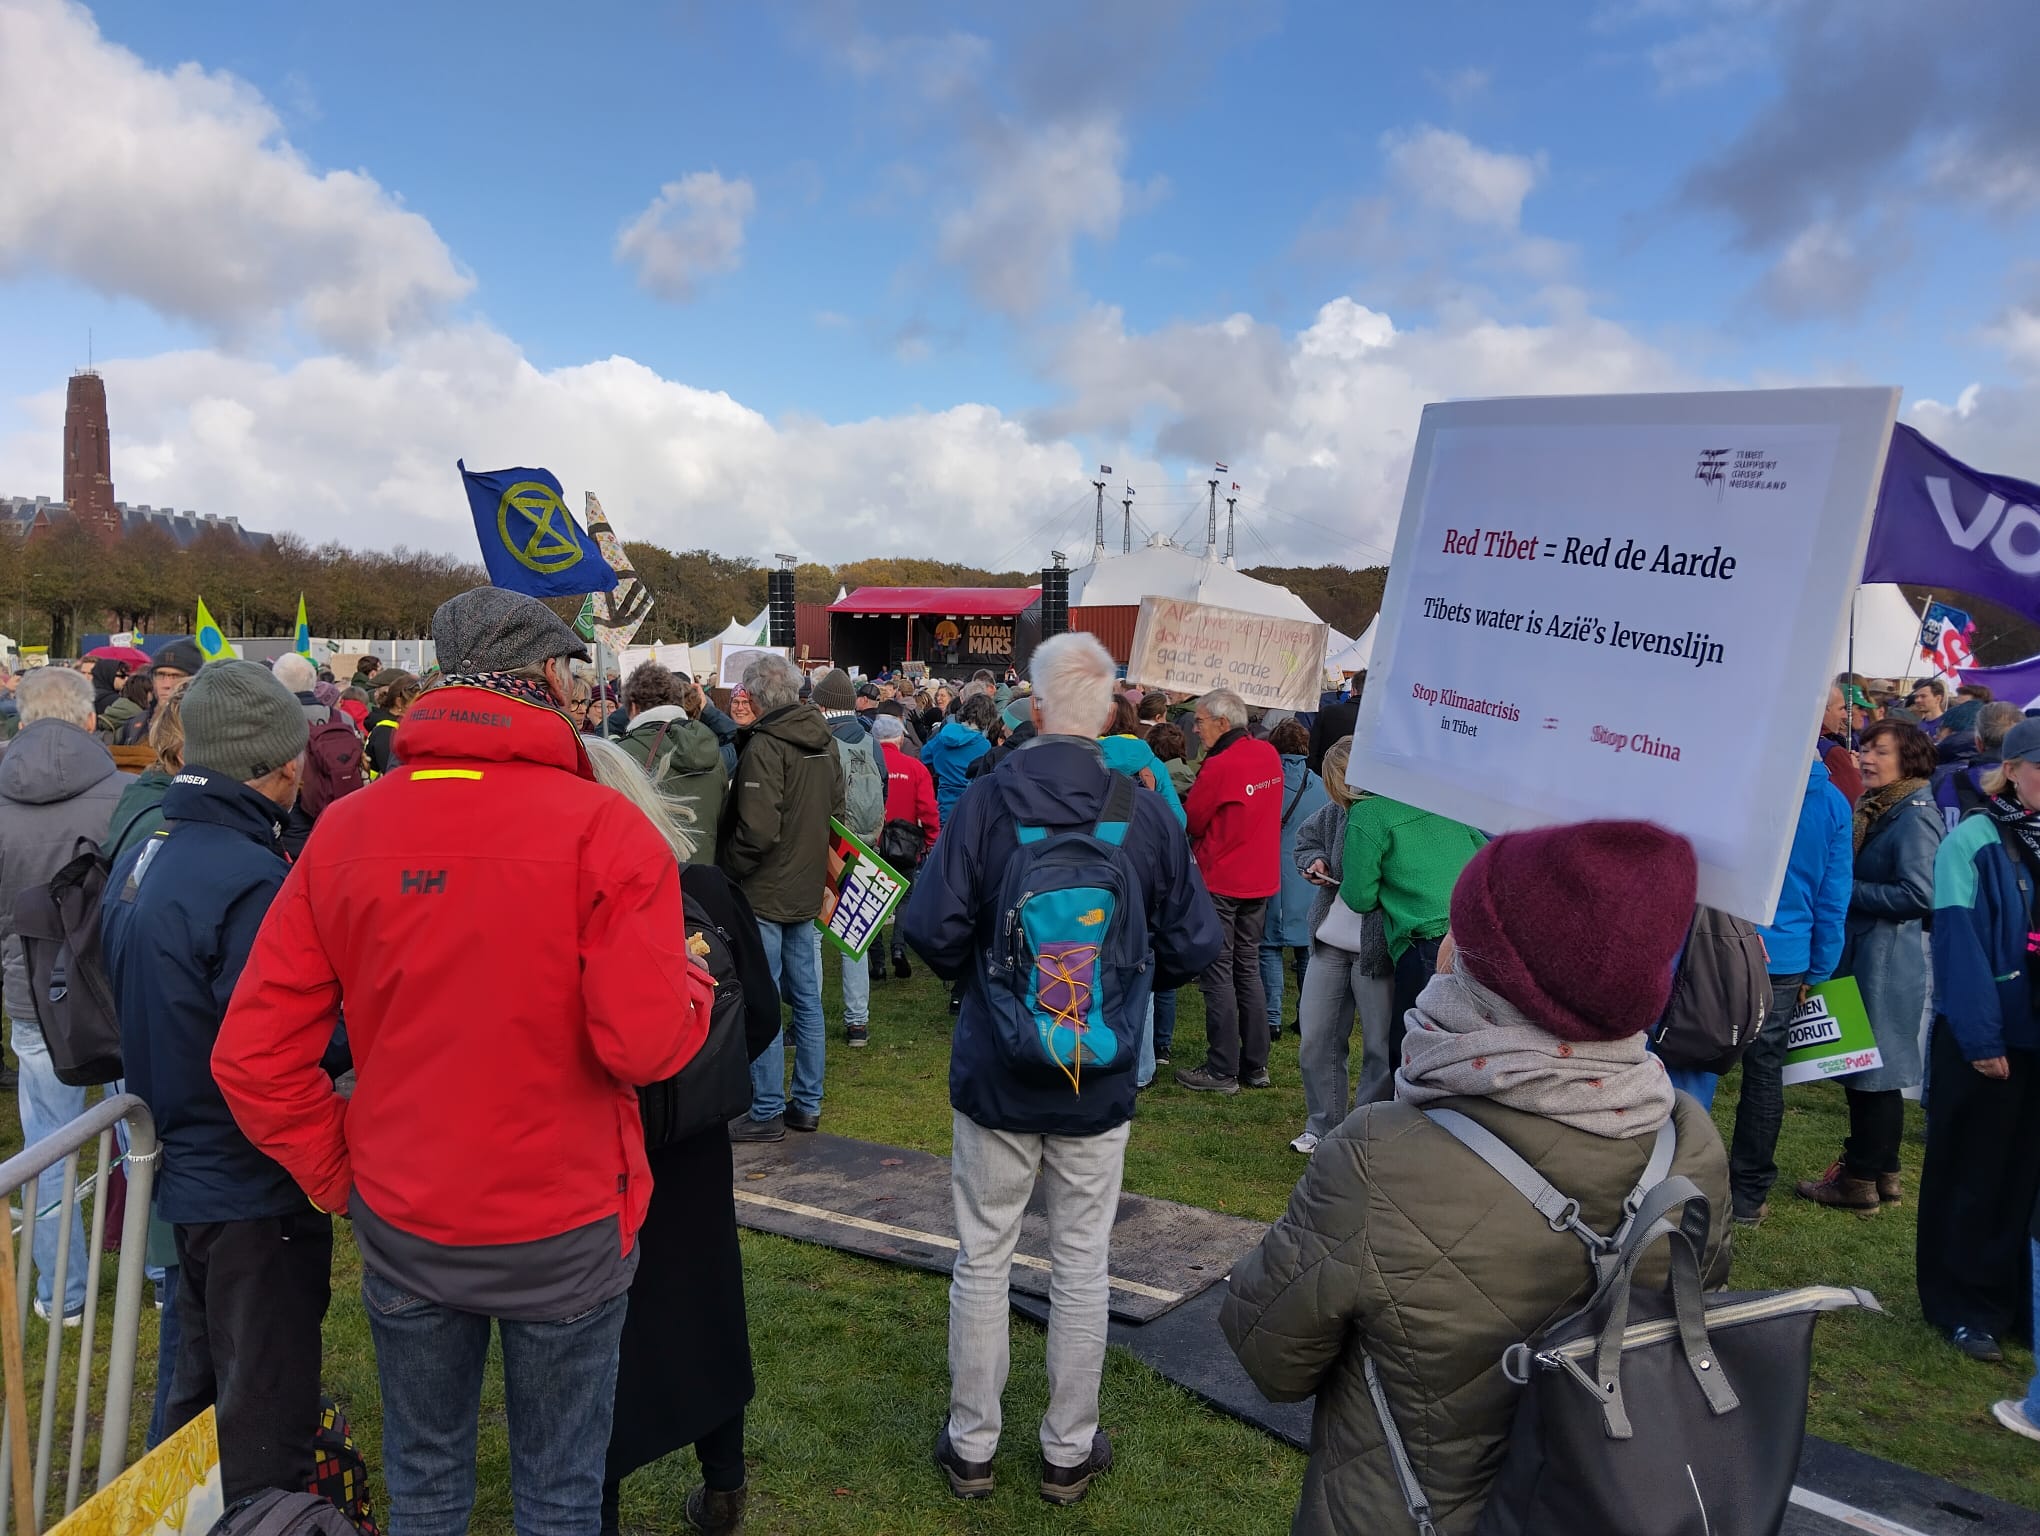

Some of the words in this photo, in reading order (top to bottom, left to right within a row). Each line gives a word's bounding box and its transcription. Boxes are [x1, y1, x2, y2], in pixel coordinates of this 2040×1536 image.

[1728, 480, 1788, 491] NEDERLAND
[1442, 528, 1480, 556] Red
[1483, 530, 1539, 561] Tibet
[1543, 542, 1558, 558] =
[1561, 536, 1612, 568] Red
[1614, 539, 1646, 571] de
[1649, 544, 1737, 580] Aarde
[969, 625, 1012, 637] KLIMAAT
[1423, 597, 1472, 624] Tibets
[1475, 607, 1524, 632] water
[1525, 609, 1543, 635] is
[1609, 621, 1725, 668] levenslijn
[968, 637, 1012, 655] MARS
[1157, 648, 1197, 665] gaat
[1204, 653, 1223, 669] de
[1228, 660, 1271, 680] aarde
[1165, 668, 1204, 685] naar
[1211, 672, 1229, 689] de
[1239, 679, 1281, 698] maan
[410, 707, 447, 722] HELLY
[449, 709, 513, 729] HANSEN
[1412, 683, 1438, 706] Stop
[1439, 688, 1521, 722] Klimaatcrisis
[1590, 724, 1628, 752] Stop
[1630, 733, 1682, 762] China
[1441, 715, 1451, 730] in
[1452, 718, 1478, 738] Tibet
[400, 869, 448, 895] HH
[829, 906, 851, 938] WIJ
[841, 852, 880, 915] ZIJN
[844, 915, 867, 951] MET
[859, 870, 898, 926] MEER
[1791, 998, 1823, 1020] AMEN
[1789, 1021, 1833, 1044] OORUIT
